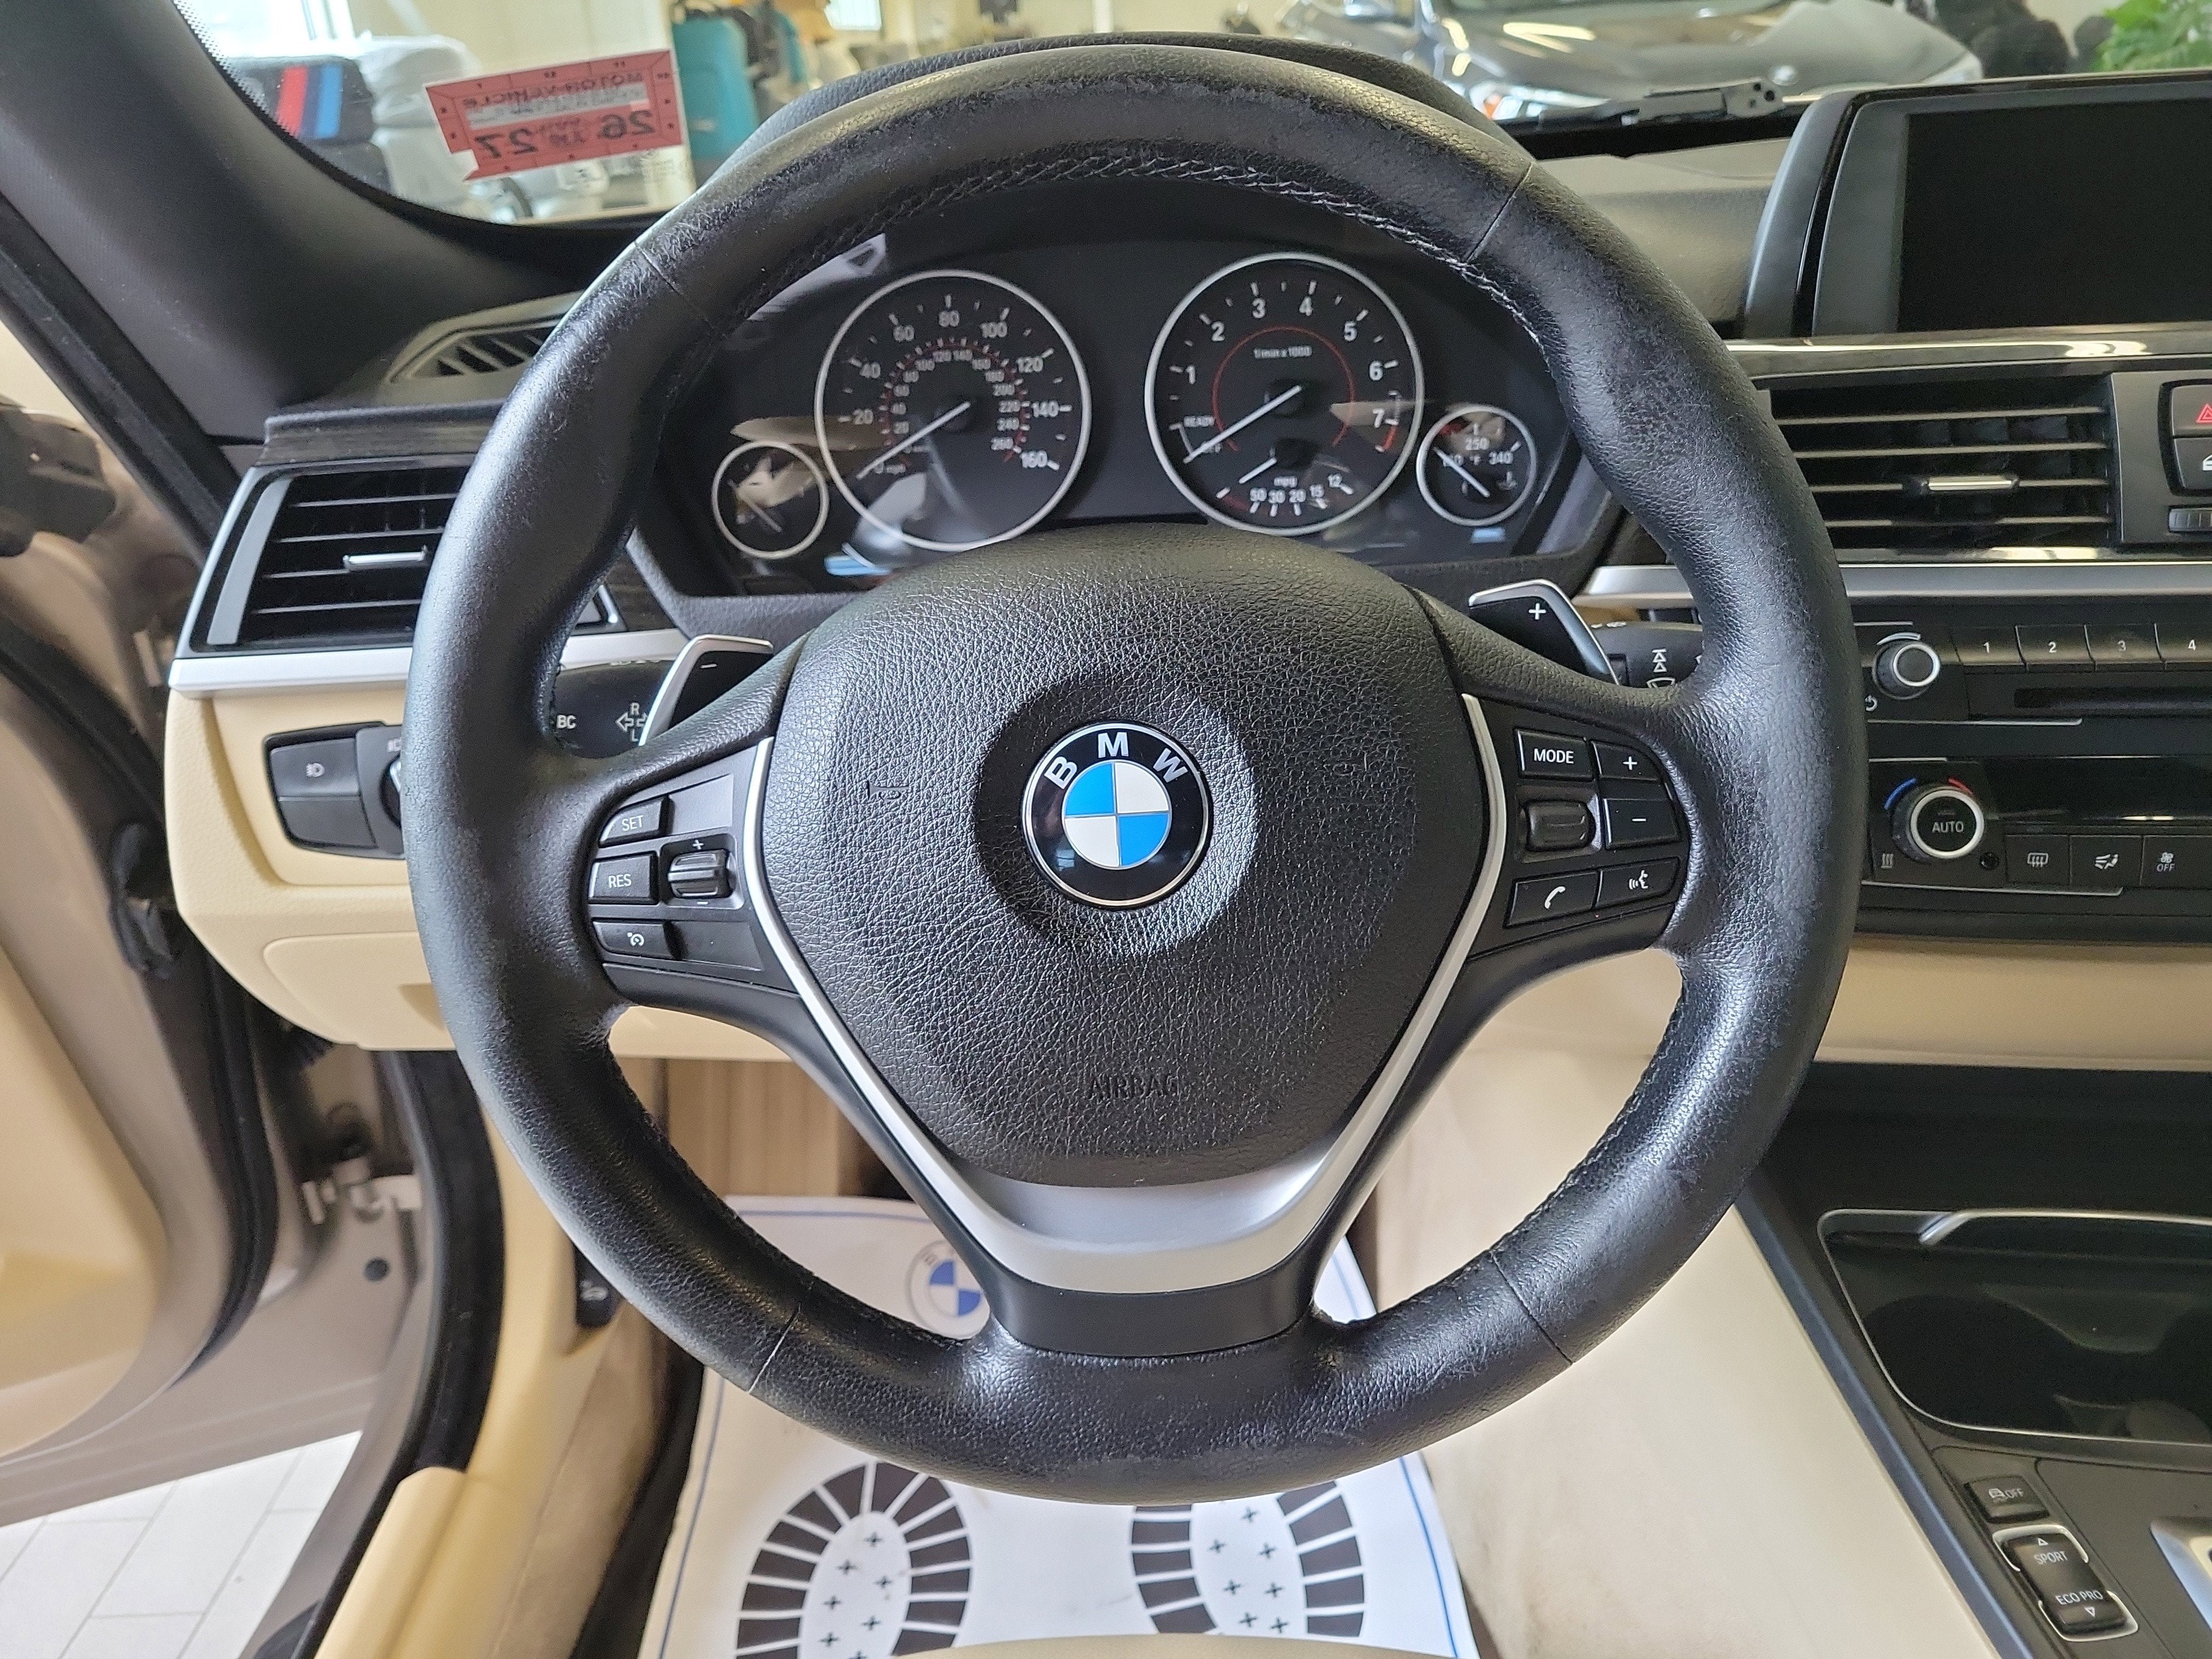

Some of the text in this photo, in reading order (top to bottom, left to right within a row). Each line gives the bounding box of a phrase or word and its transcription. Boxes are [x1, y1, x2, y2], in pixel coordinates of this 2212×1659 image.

[1252, 298, 1266, 319] 3
[1299, 296, 1313, 317] 4
[980, 321, 1008, 338] 100
[1211, 321, 1225, 342] 2
[1344, 321, 1358, 342] 5
[859, 363, 881, 379] 40
[1017, 357, 1043, 373] 120
[1369, 360, 1383, 381] 6
[1186, 365, 1196, 384] 1
[853, 409, 873, 425] 20
[1031, 401, 1060, 417] 140
[1372, 409, 1385, 427] 7
[1020, 450, 1048, 469] 160
[1289, 488, 1306, 503] 20
[1983, 641, 1990, 653] 1
[2048, 642, 2057, 653] 2
[2117, 640, 2126, 652] 3
[2187, 639, 2197, 651] 4
[630, 703, 639, 714] R
[556, 715, 577, 729] BC
[630, 730, 639, 742] L
[1044, 731, 1189, 789] BMW
[1533, 748, 1574, 764] MODE
[621, 815, 644, 832] SET
[1931, 821, 1964, 834] AUTO
[2157, 863, 2176, 872] OFF
[608, 873, 632, 889] RES
[2005, 1488, 2024, 1499] OFF
[2034, 1551, 2068, 1565] SPORT
[2055, 1590, 2104, 1605] ECO PRO
